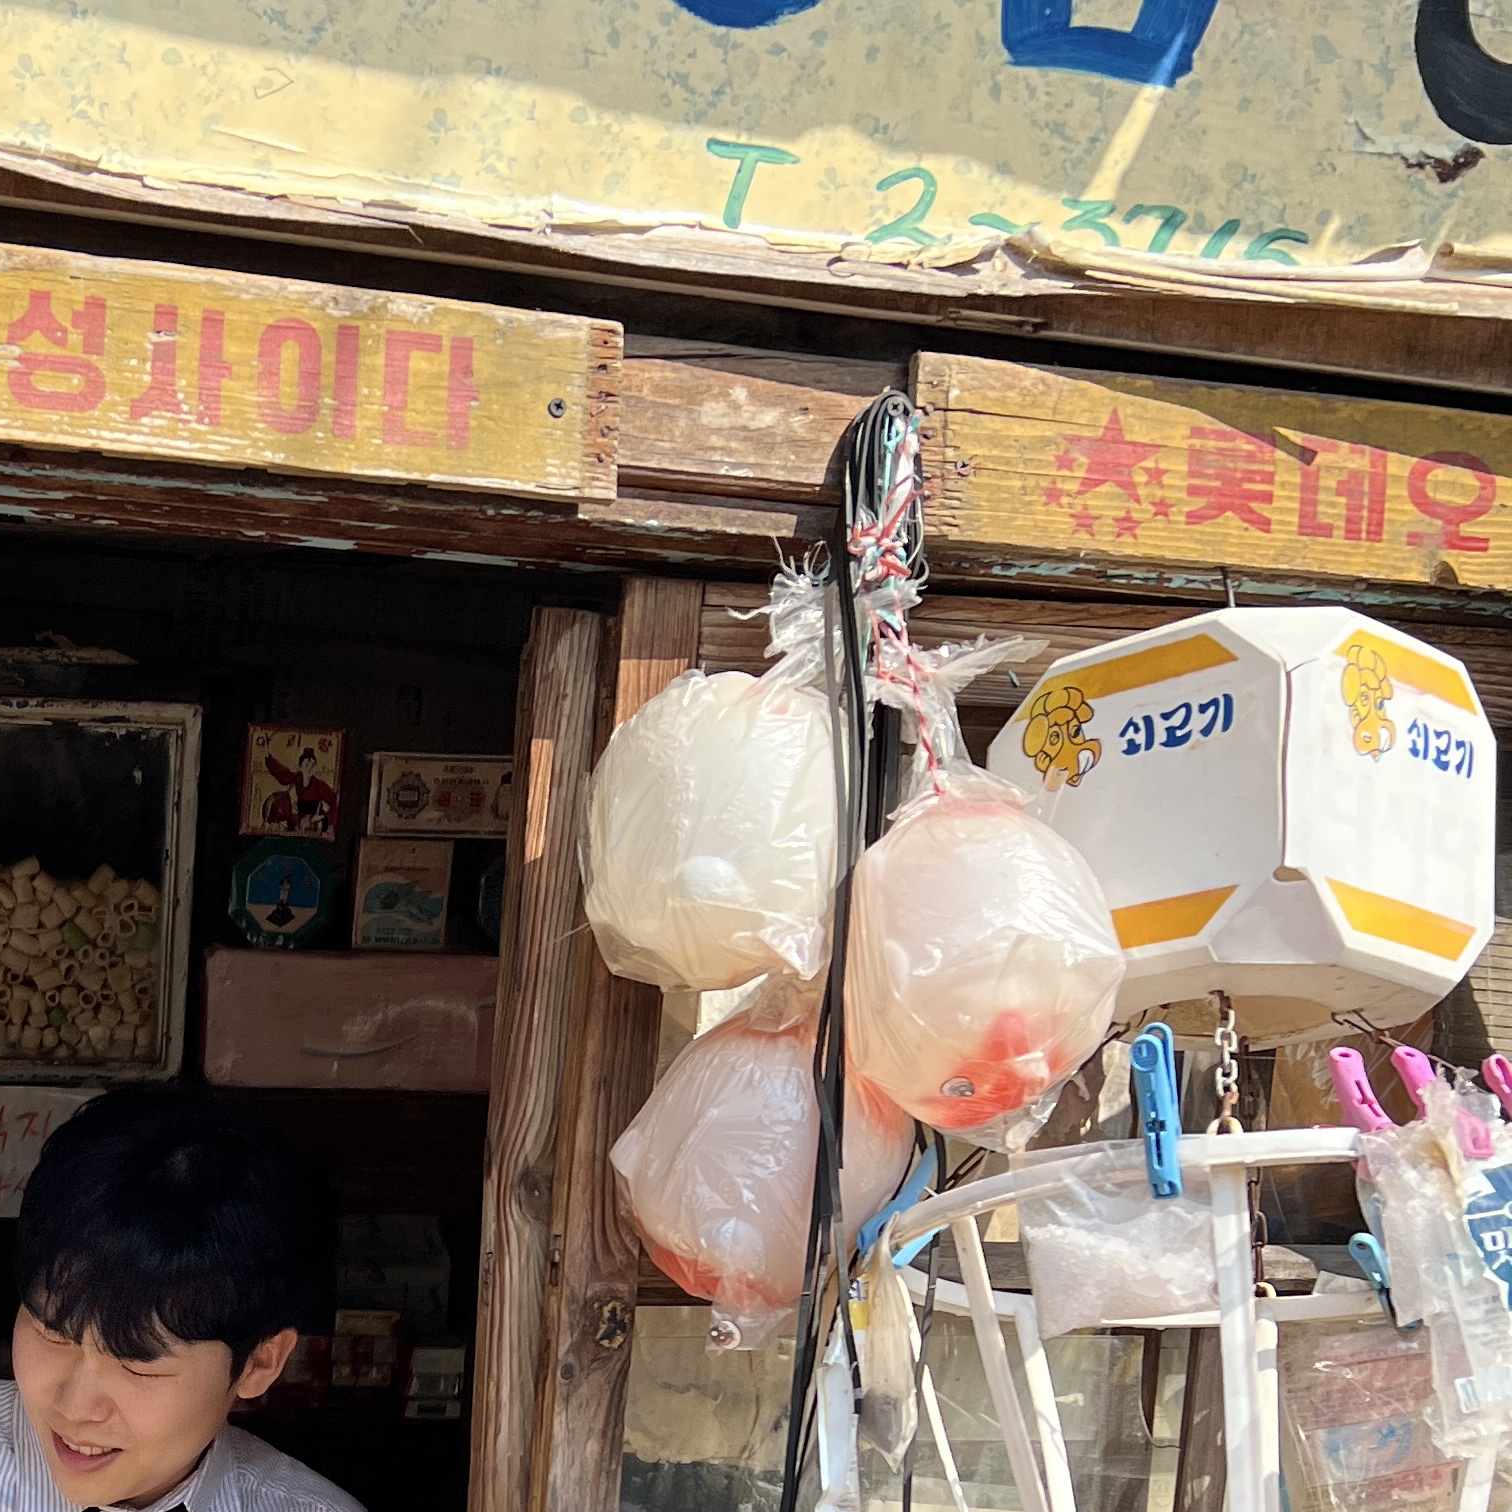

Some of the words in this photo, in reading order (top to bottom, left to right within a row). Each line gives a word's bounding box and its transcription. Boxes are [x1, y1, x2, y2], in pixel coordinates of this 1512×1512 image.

[706, 137, 799, 229] T
[1119, 693, 1233, 756] 쇠고기
[1407, 718, 1474, 779] 쇠고기
